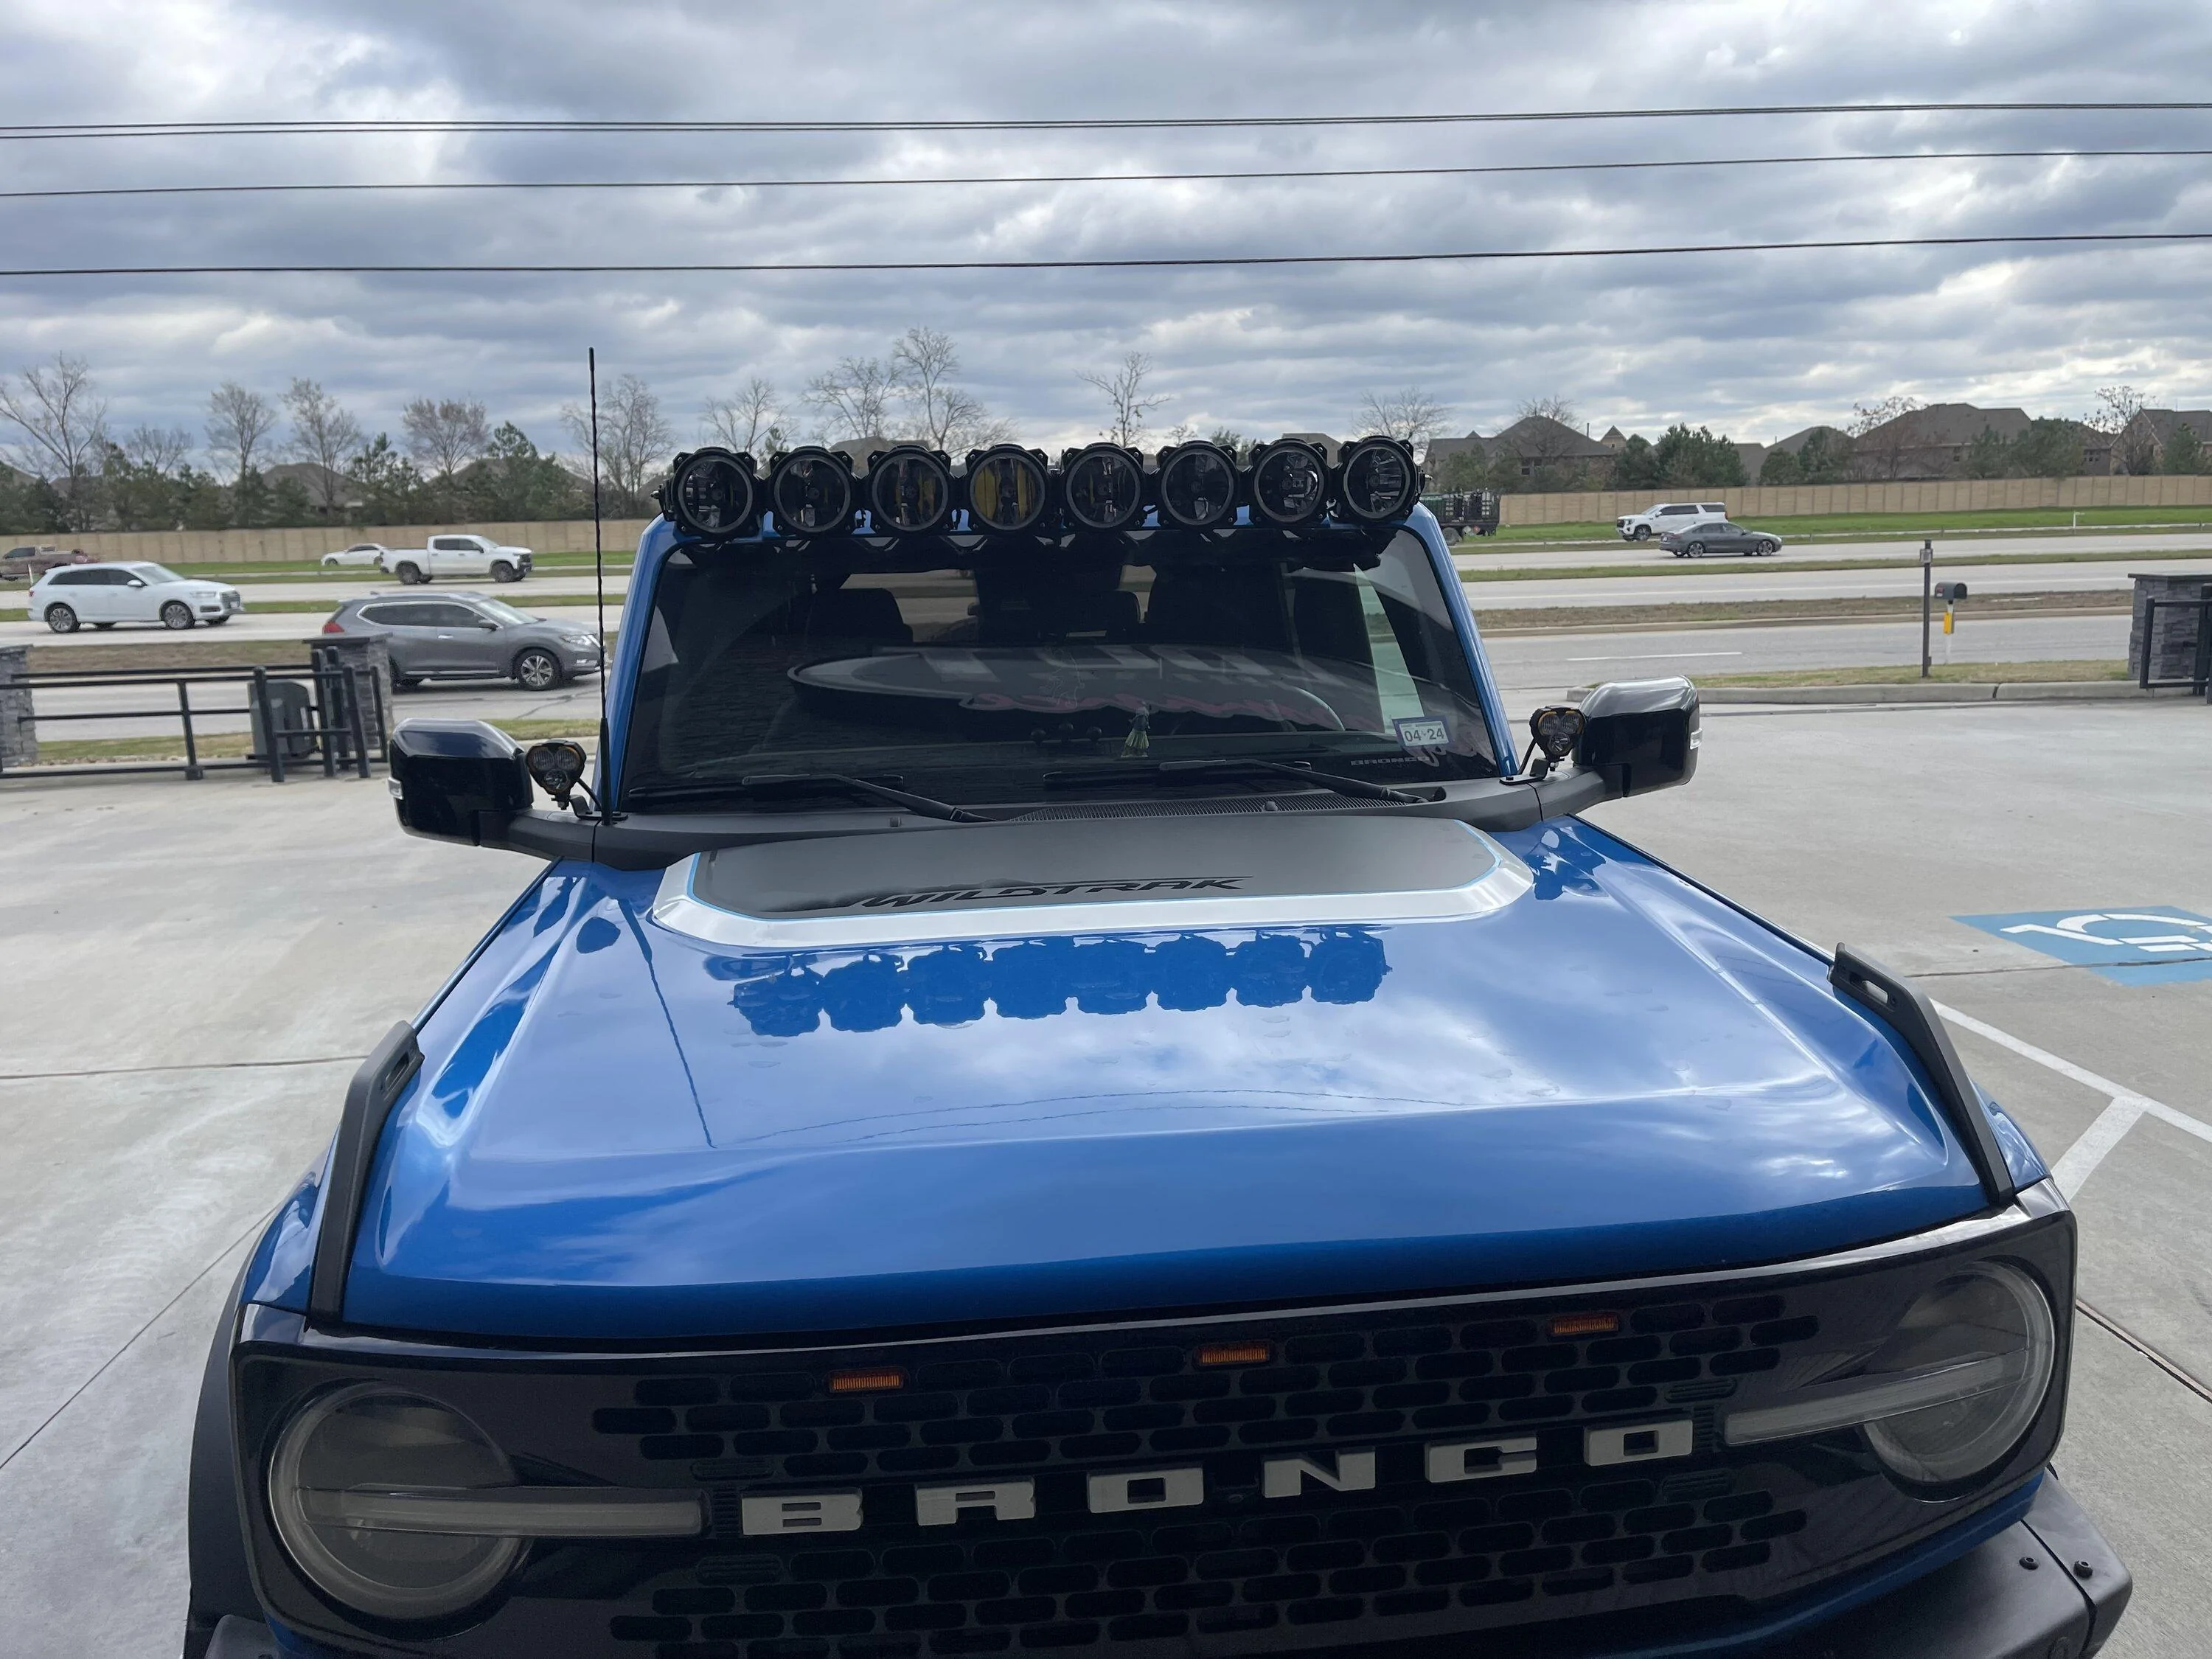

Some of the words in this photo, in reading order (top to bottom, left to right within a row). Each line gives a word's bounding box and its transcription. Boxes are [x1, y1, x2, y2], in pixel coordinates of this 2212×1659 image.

[1350, 757, 1430, 765] BRONCO
[855, 876, 1253, 908] WILDTRAK
[741, 1419, 1694, 1536] BRONCO
